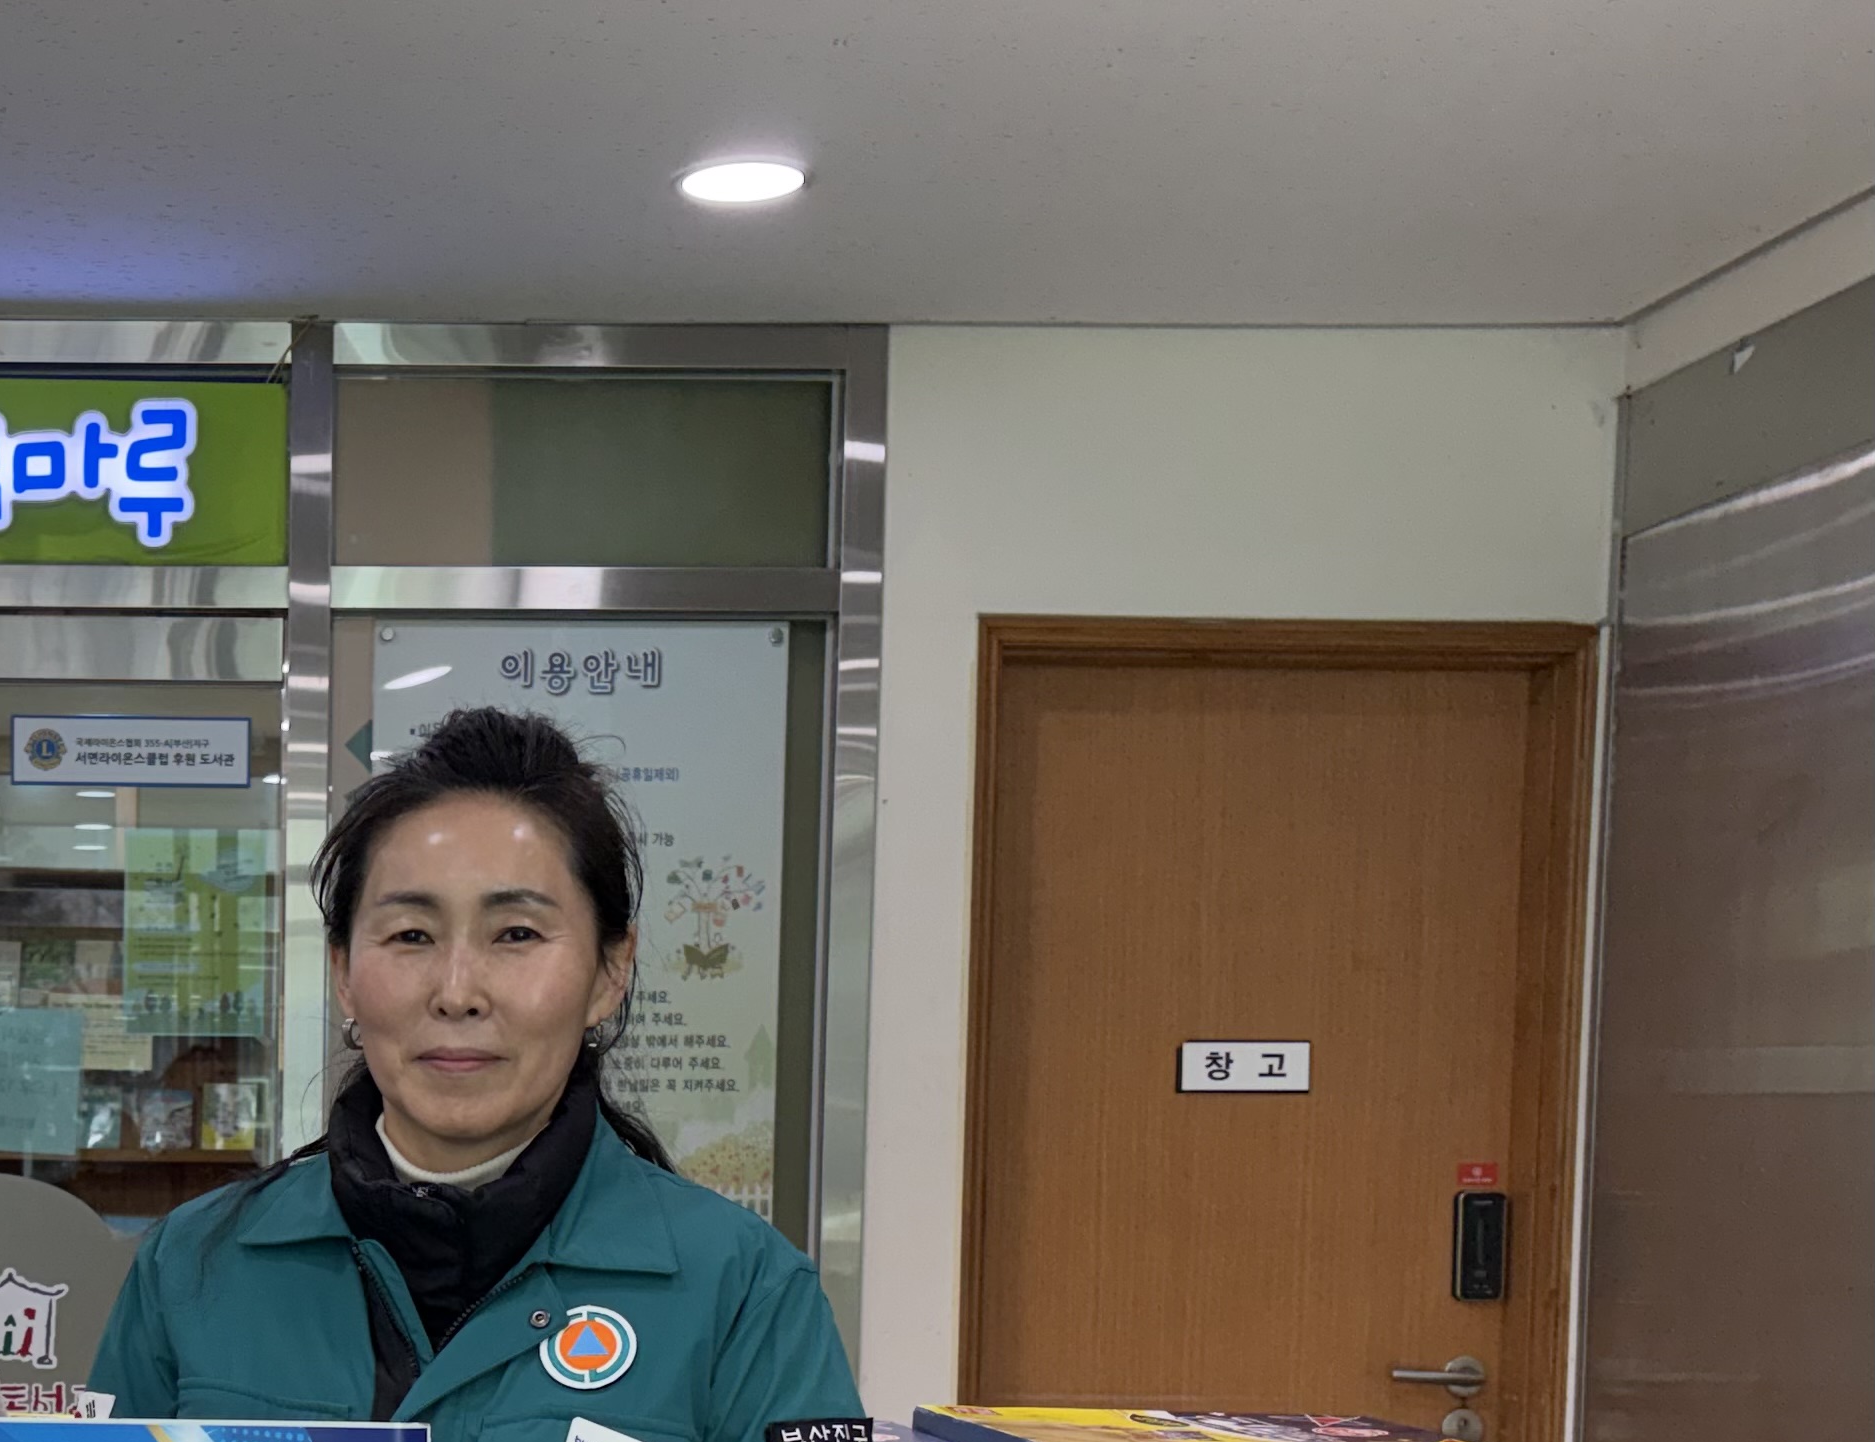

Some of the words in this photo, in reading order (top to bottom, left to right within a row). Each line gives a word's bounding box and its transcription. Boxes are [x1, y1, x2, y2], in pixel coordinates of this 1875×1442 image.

[501, 648, 661, 695] 이용안내
[75, 752, 168, 766] 서면라이온스클럽
[173, 753, 195, 766] 후원
[200, 754, 235, 767] 도서관
[652, 833, 674, 846] 가능
